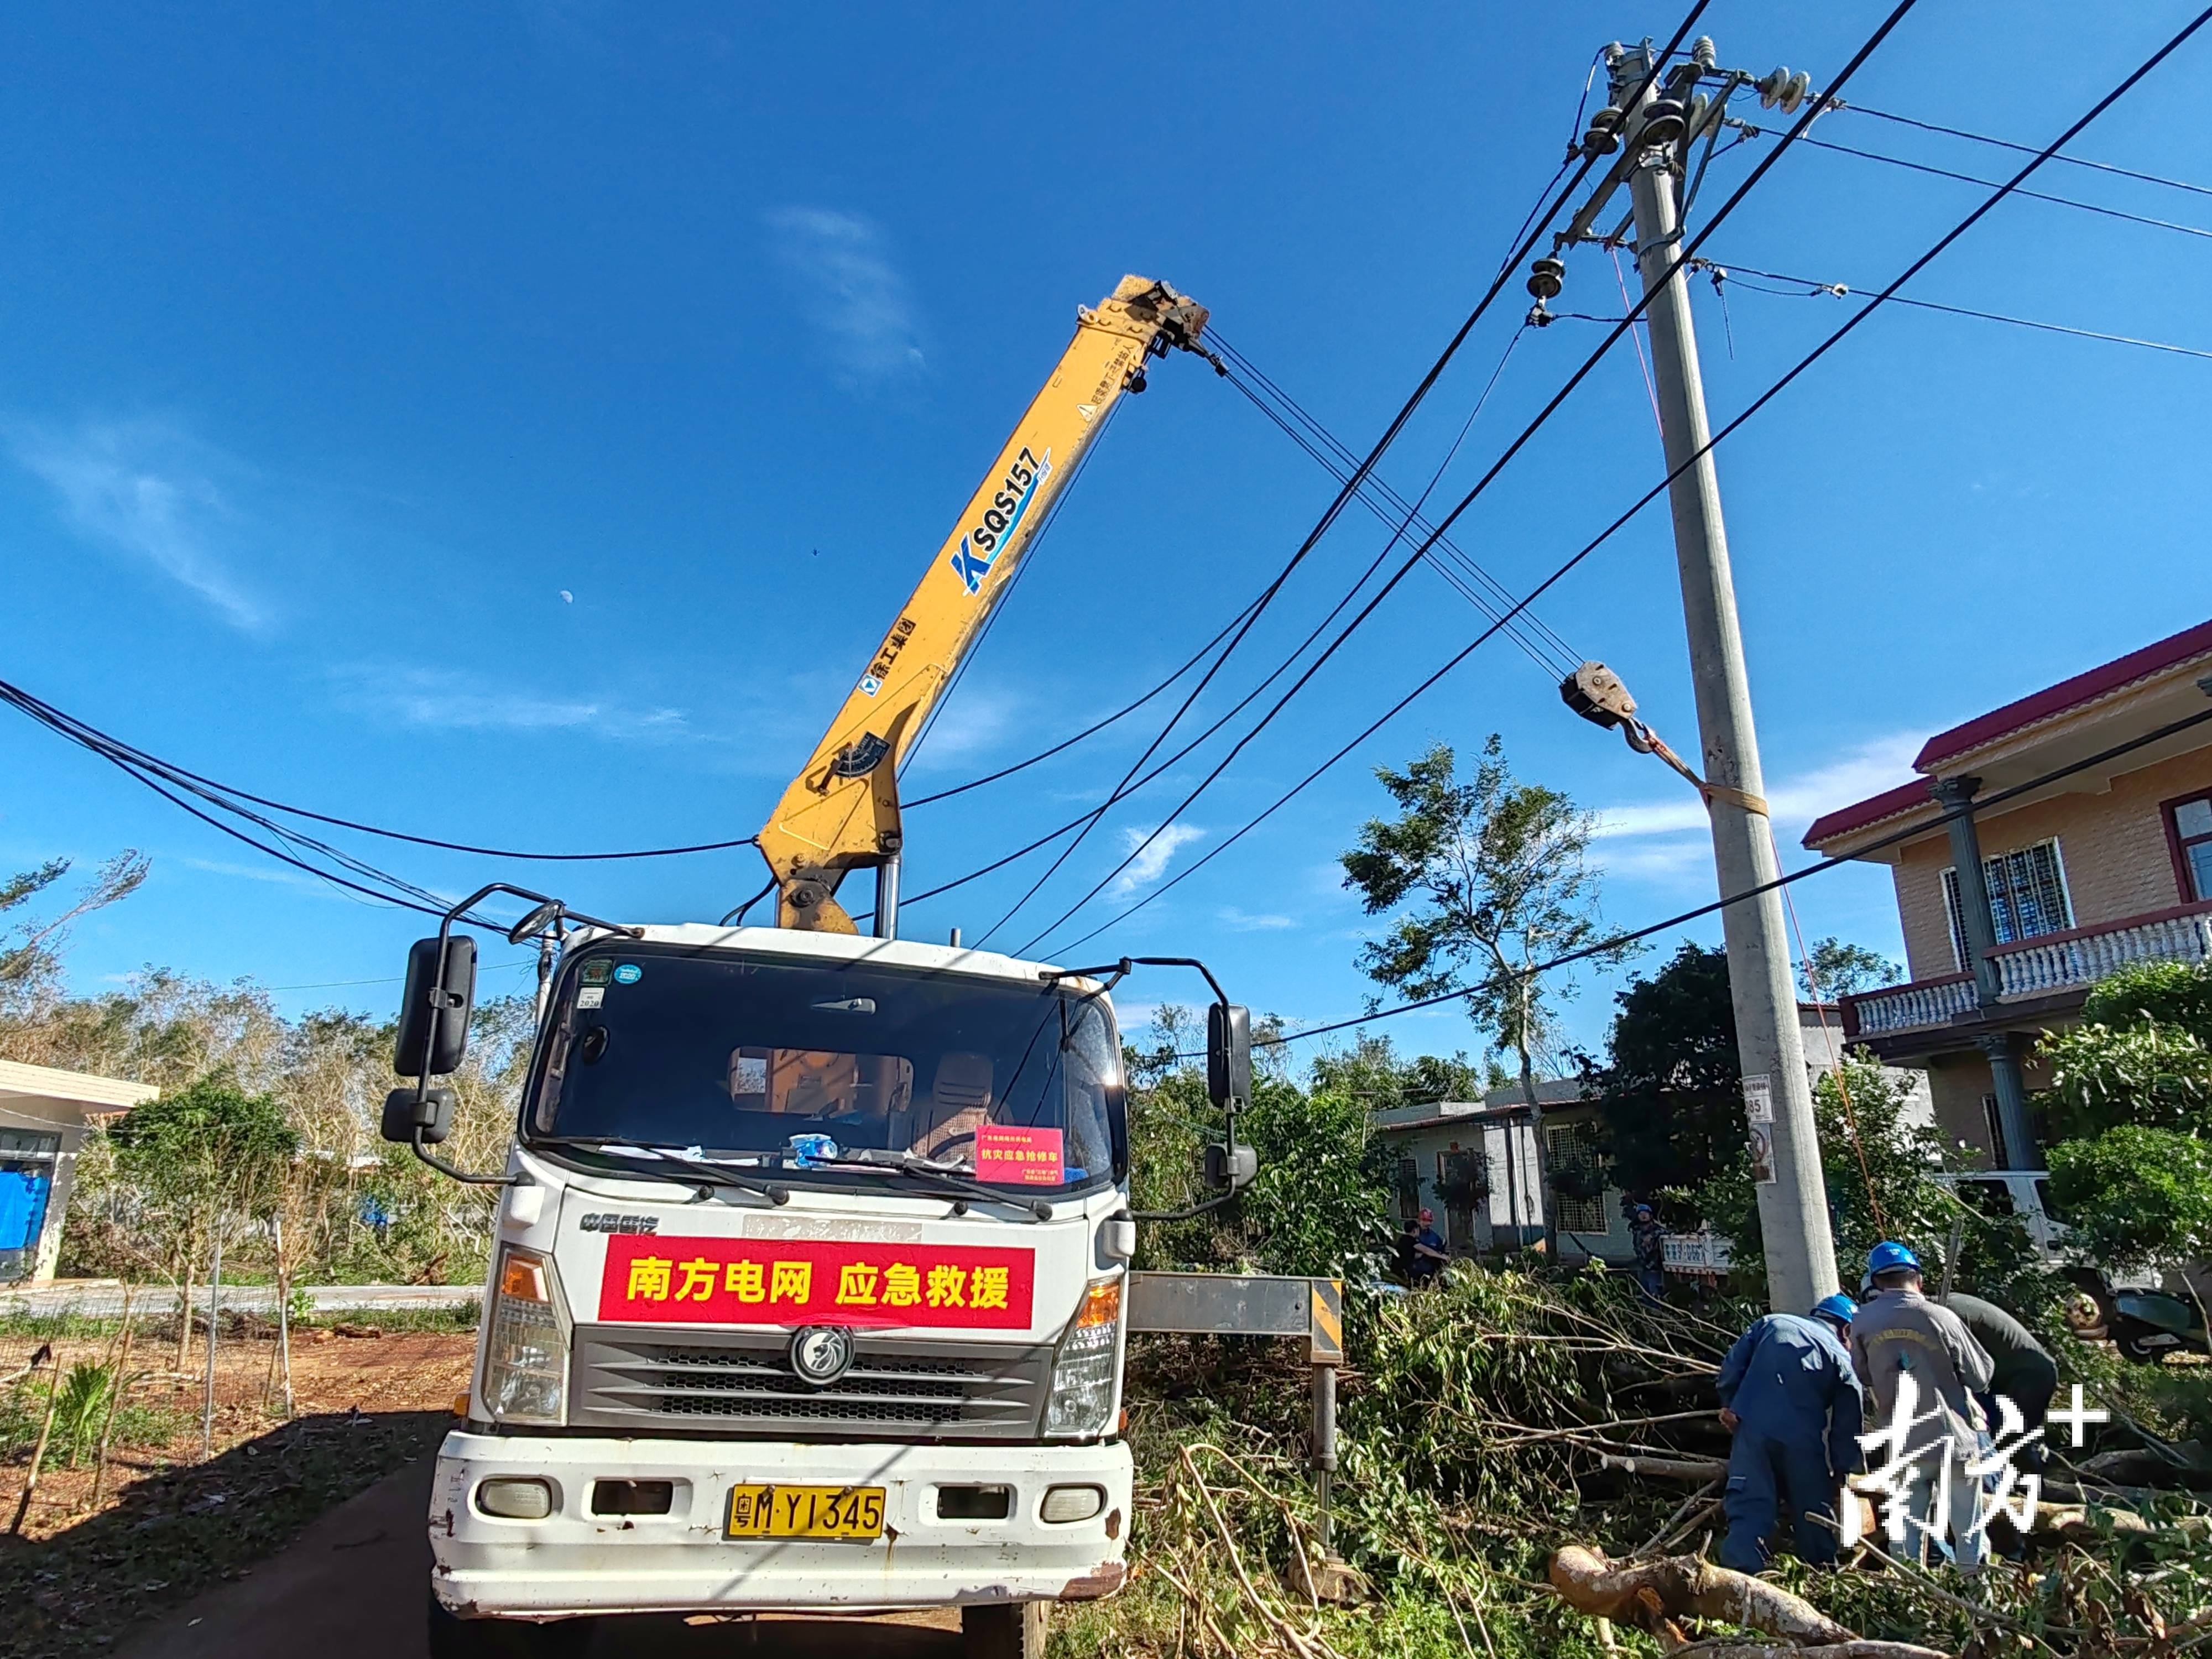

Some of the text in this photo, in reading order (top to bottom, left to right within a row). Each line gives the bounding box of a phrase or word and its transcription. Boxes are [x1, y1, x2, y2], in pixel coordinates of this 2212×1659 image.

[973, 447, 1040, 552] SQS157
[870, 618, 916, 680] 徐工集团
[982, 1148, 1058, 1162] 抗灾应急抢修车
[580, 1213, 660, 1237] 中国重汽
[627, 1256, 1010, 1310] 南方电网 应急救援
